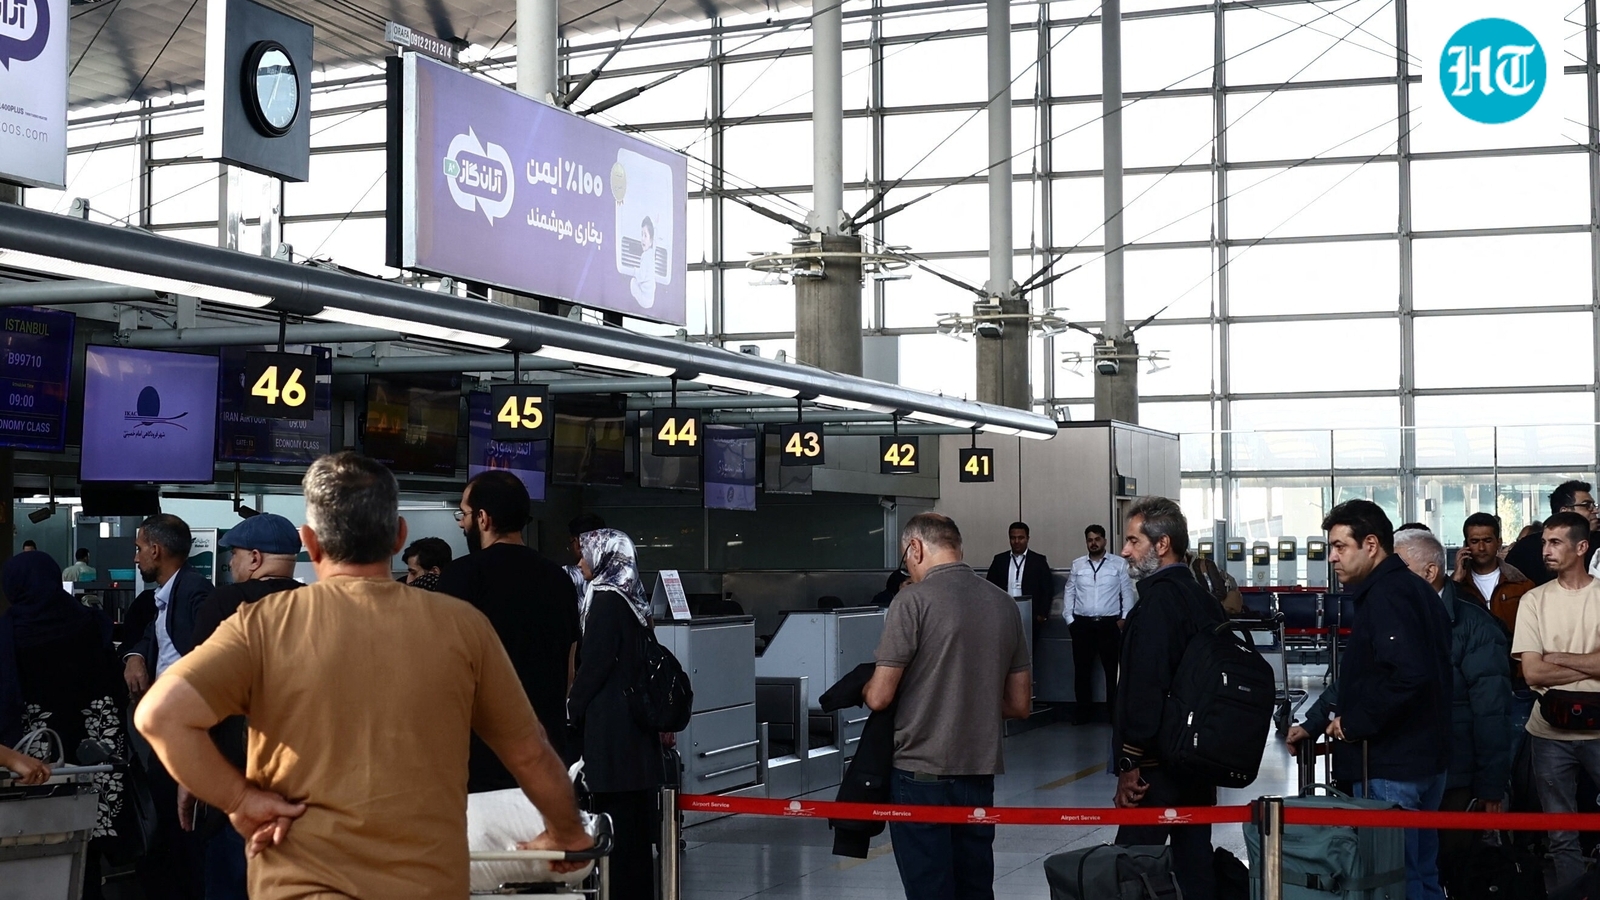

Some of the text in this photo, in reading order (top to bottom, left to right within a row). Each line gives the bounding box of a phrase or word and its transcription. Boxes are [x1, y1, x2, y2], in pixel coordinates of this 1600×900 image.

[526, 157, 562, 195] ایمن
[526, 207, 603, 251] بخاری هوشمند
[5, 317, 50, 336] ISTANBUL
[8, 352, 42, 368] B99710
[251, 366, 306, 407] 46
[9, 393, 34, 408] 09:00
[223, 411, 239, 422] IRAN
[497, 395, 543, 429] 45
[26, 421, 51, 433] CLASS
[657, 417, 697, 446] 44
[275, 438, 320, 450] ECONOMY CLASS
[785, 431, 821, 457] 43
[884, 443, 916, 467] 42
[964, 455, 989, 476] 41
[872, 809, 891, 817] Airport
